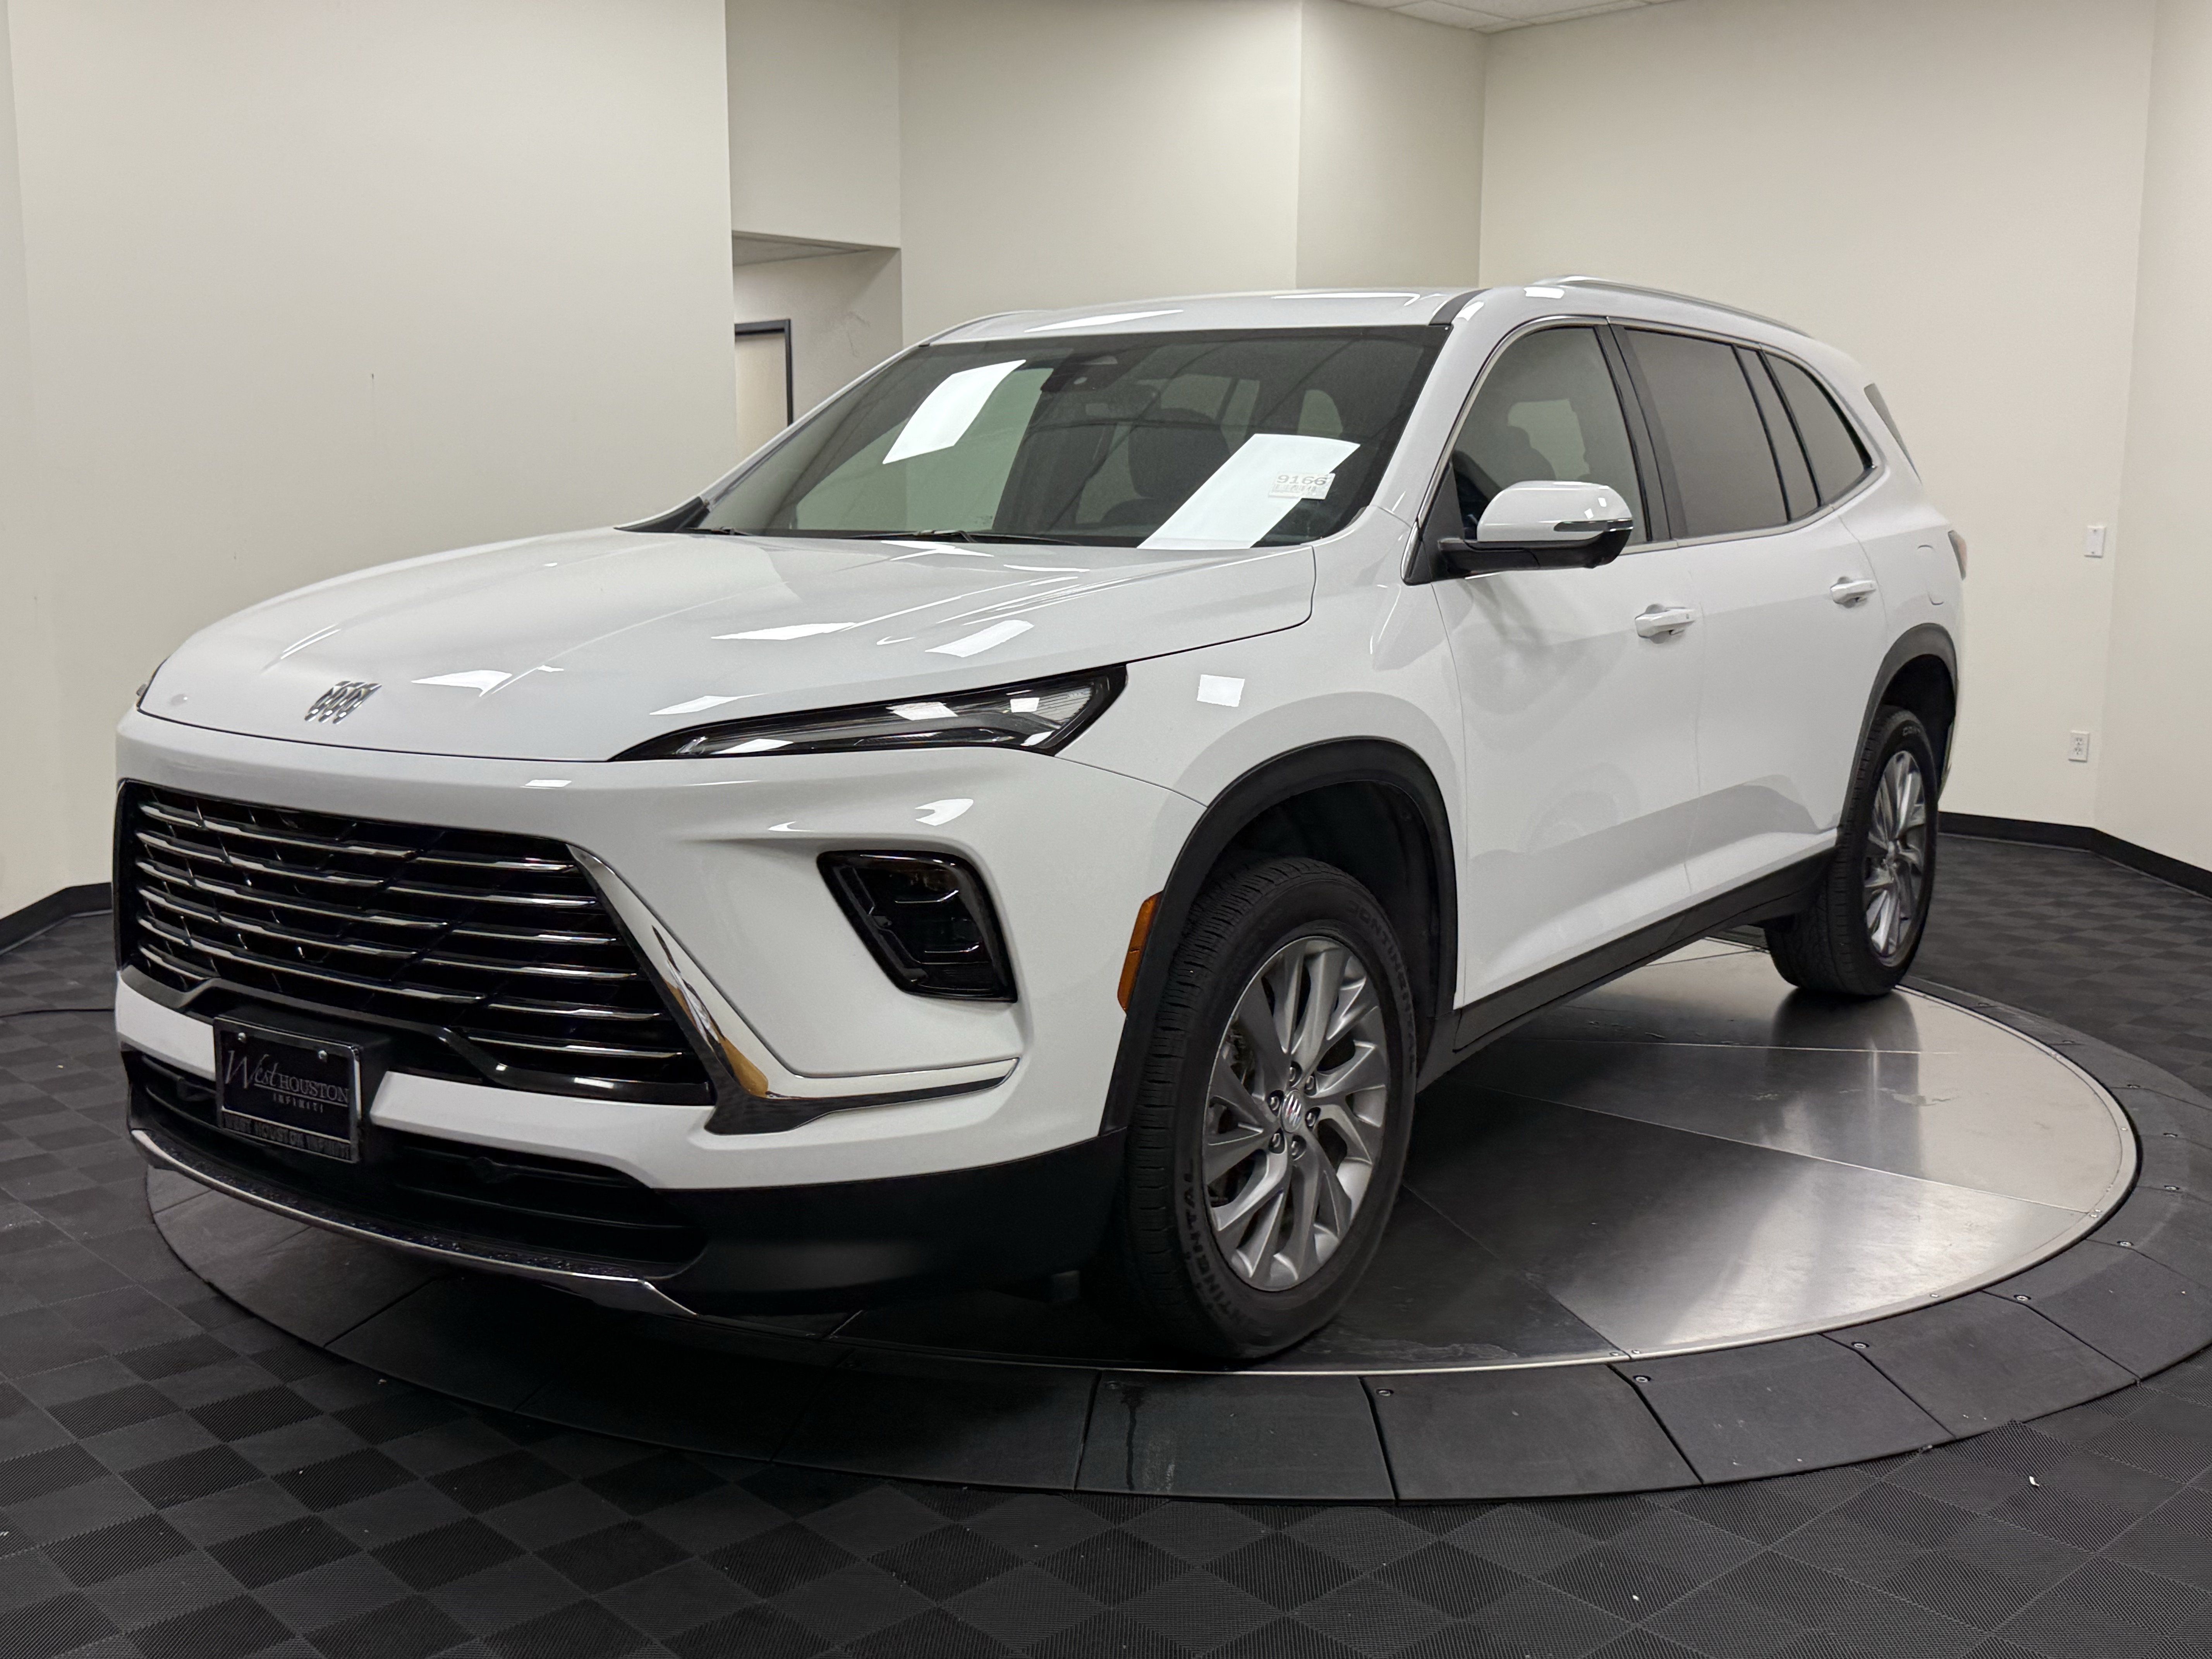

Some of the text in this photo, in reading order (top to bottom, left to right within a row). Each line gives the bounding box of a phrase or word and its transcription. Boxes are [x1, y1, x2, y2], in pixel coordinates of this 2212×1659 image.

[1276, 475, 1328, 485] 9166
[225, 1050, 349, 1103] West HOUSTON
